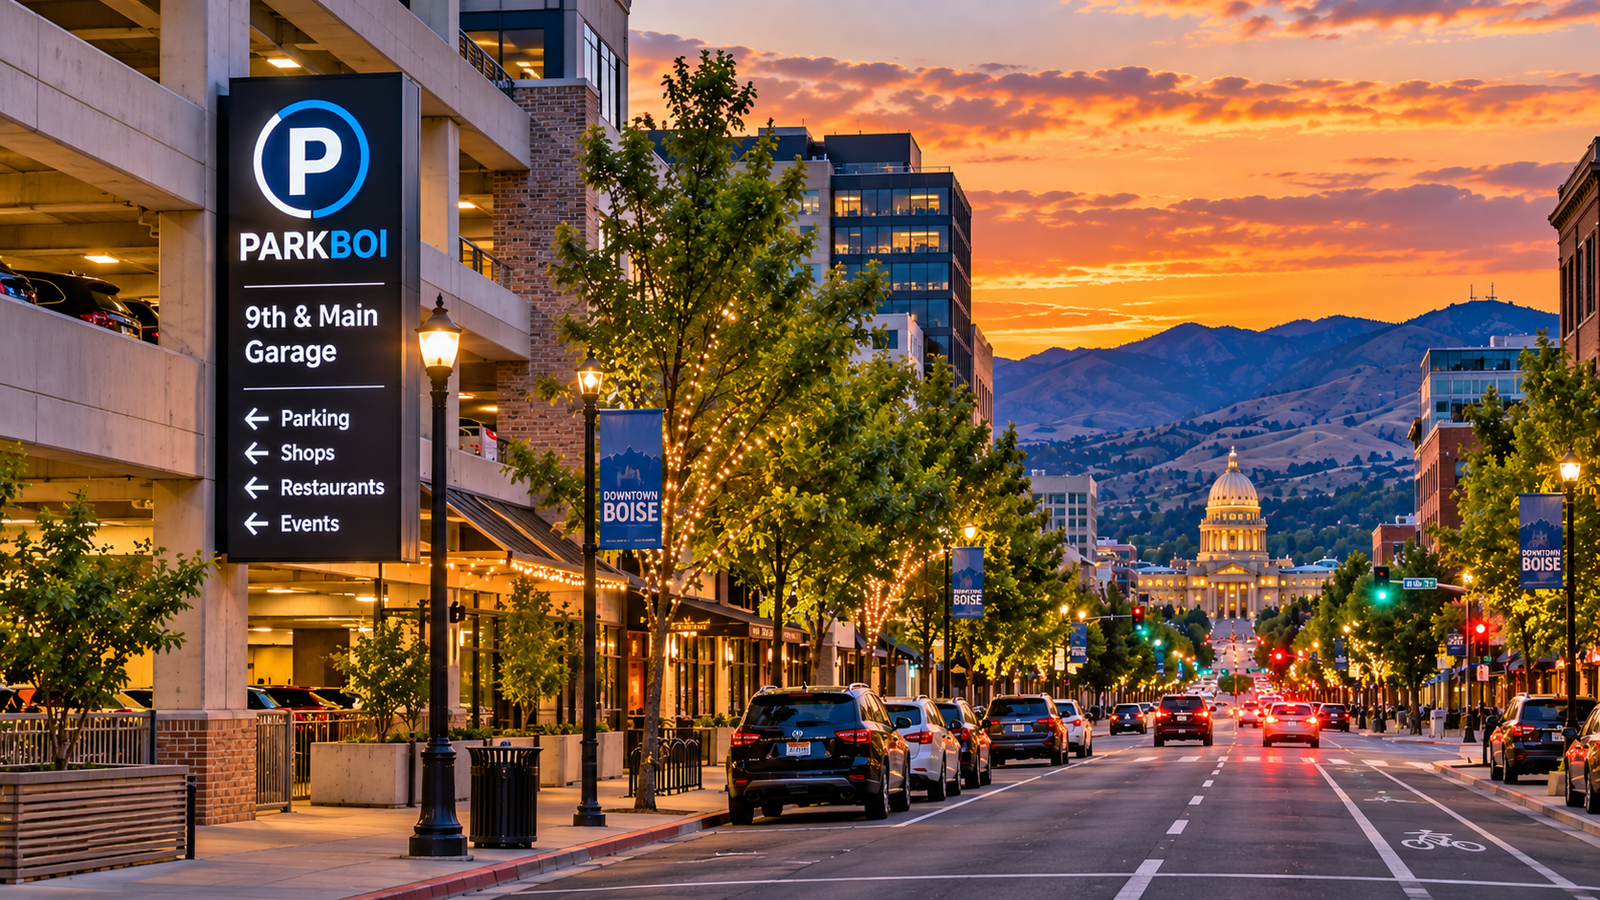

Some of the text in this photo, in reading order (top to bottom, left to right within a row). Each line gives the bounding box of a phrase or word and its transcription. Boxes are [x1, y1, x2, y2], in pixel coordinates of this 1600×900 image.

[289, 126, 342, 197] P
[239, 228, 388, 262] PARKBOI
[245, 302, 378, 330] 9th & Main
[244, 339, 337, 369] Garage
[281, 408, 350, 432] Parking
[281, 443, 335, 466] Shops
[281, 478, 385, 497] Restaurants
[603, 491, 658, 501] DOWNTOWN
[603, 501, 659, 522] BOISE
[281, 514, 340, 533] Events
[1522, 556, 1562, 572] BOISE
[953, 594, 983, 606] BOISE
